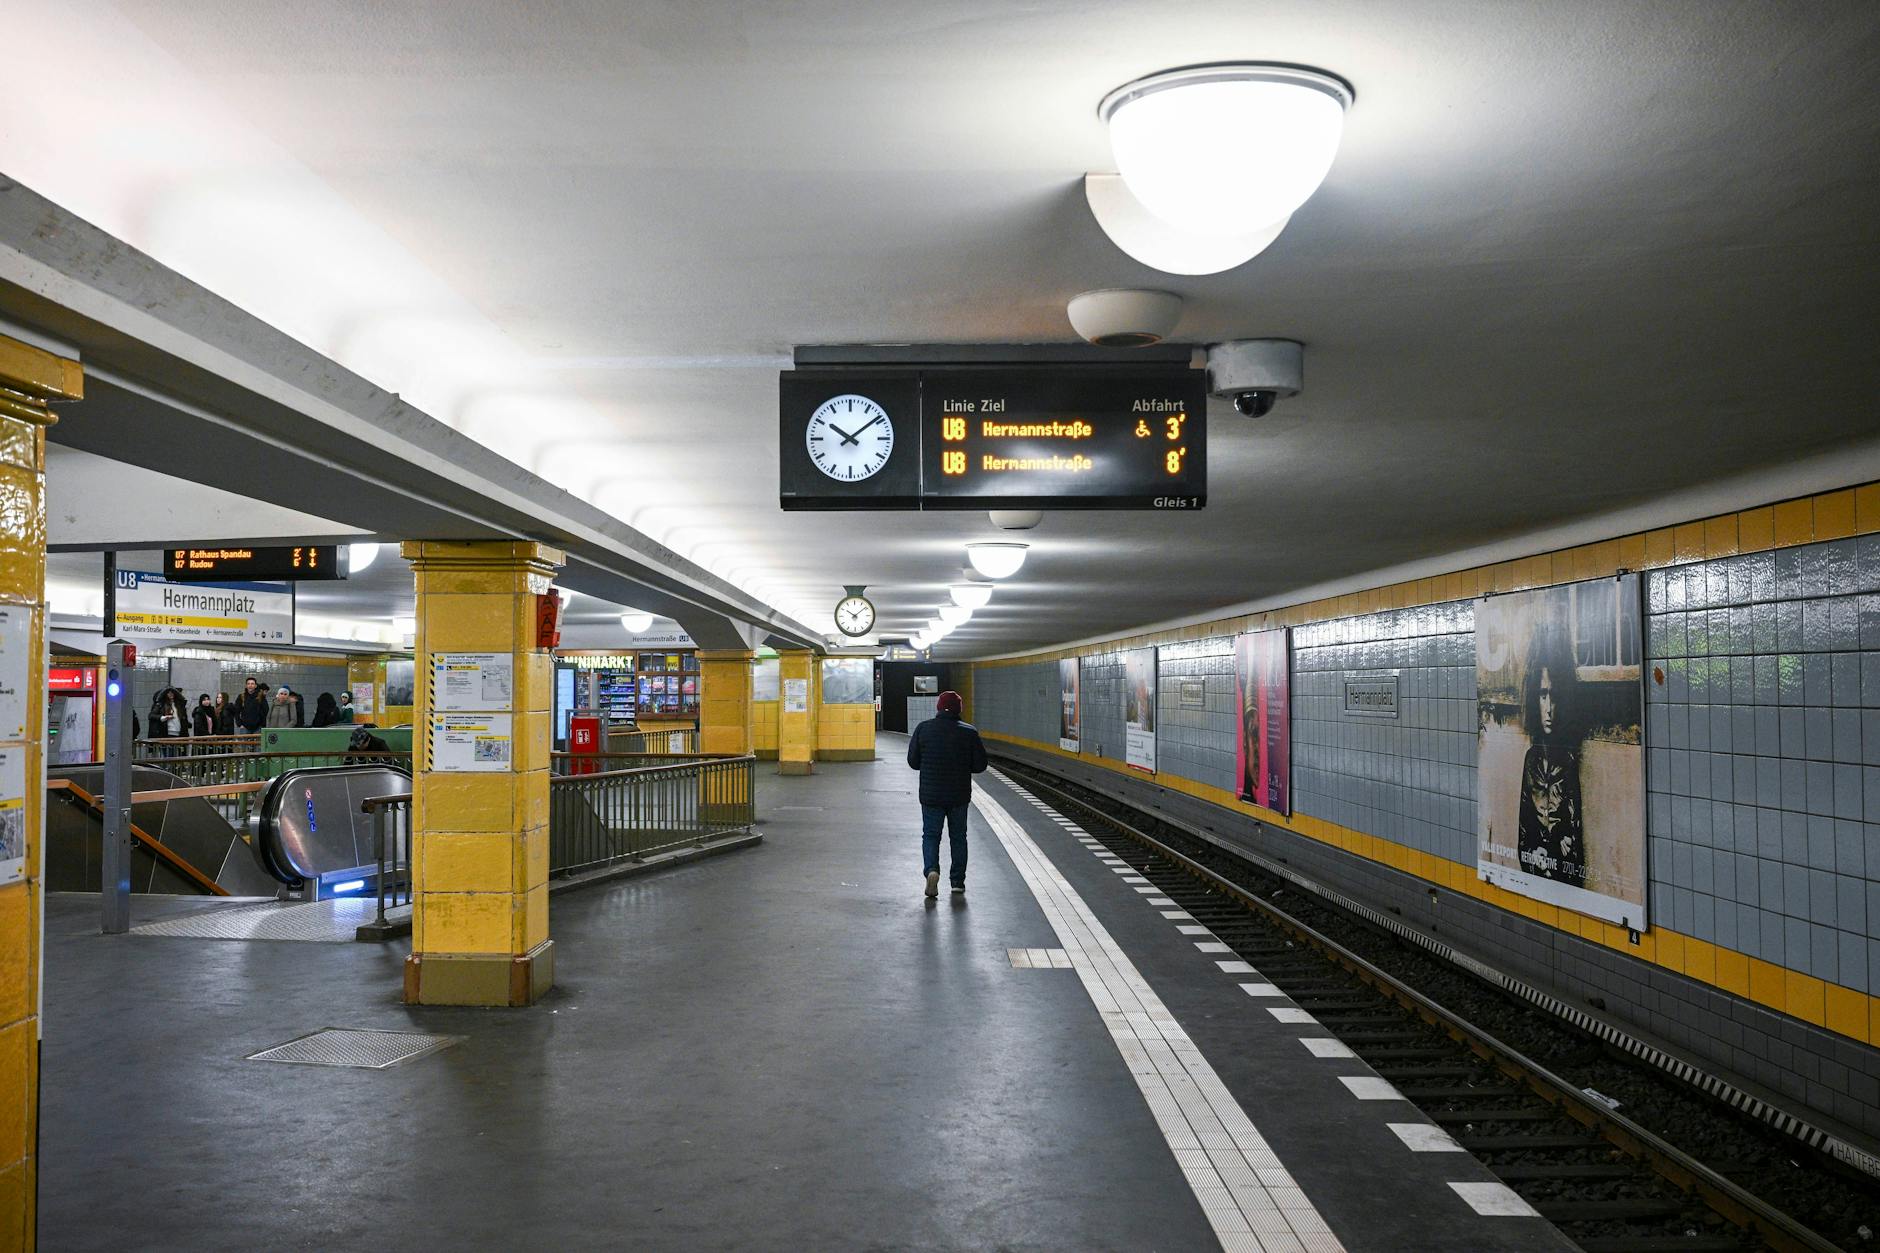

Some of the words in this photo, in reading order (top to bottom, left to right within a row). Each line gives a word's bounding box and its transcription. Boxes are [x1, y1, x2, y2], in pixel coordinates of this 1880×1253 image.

[943, 400, 975, 412] Linie
[980, 400, 1005, 412] Ziel
[1132, 400, 1185, 412] Abfahrt
[943, 418, 966, 440] U8
[982, 421, 1092, 439] Hermannstraße
[943, 451, 966, 474] U8
[982, 455, 1092, 472] Hermannstraße
[1153, 497, 1187, 508] Gleis
[1191, 497, 1198, 508] 1
[175, 550, 185, 559] U7
[189, 550, 219, 559] Rathaus
[220, 550, 251, 560] Spandau
[175, 560, 185, 569] U7
[189, 560, 213, 569] Rudow
[118, 571, 136, 588] U8
[163, 588, 255, 616] Hermannplatz
[123, 614, 144, 624] Ausgang
[632, 635, 677, 643] Hermannstraße
[1350, 685, 1393, 706] Hermannplatz
[1631, 932, 1638, 944] 4
